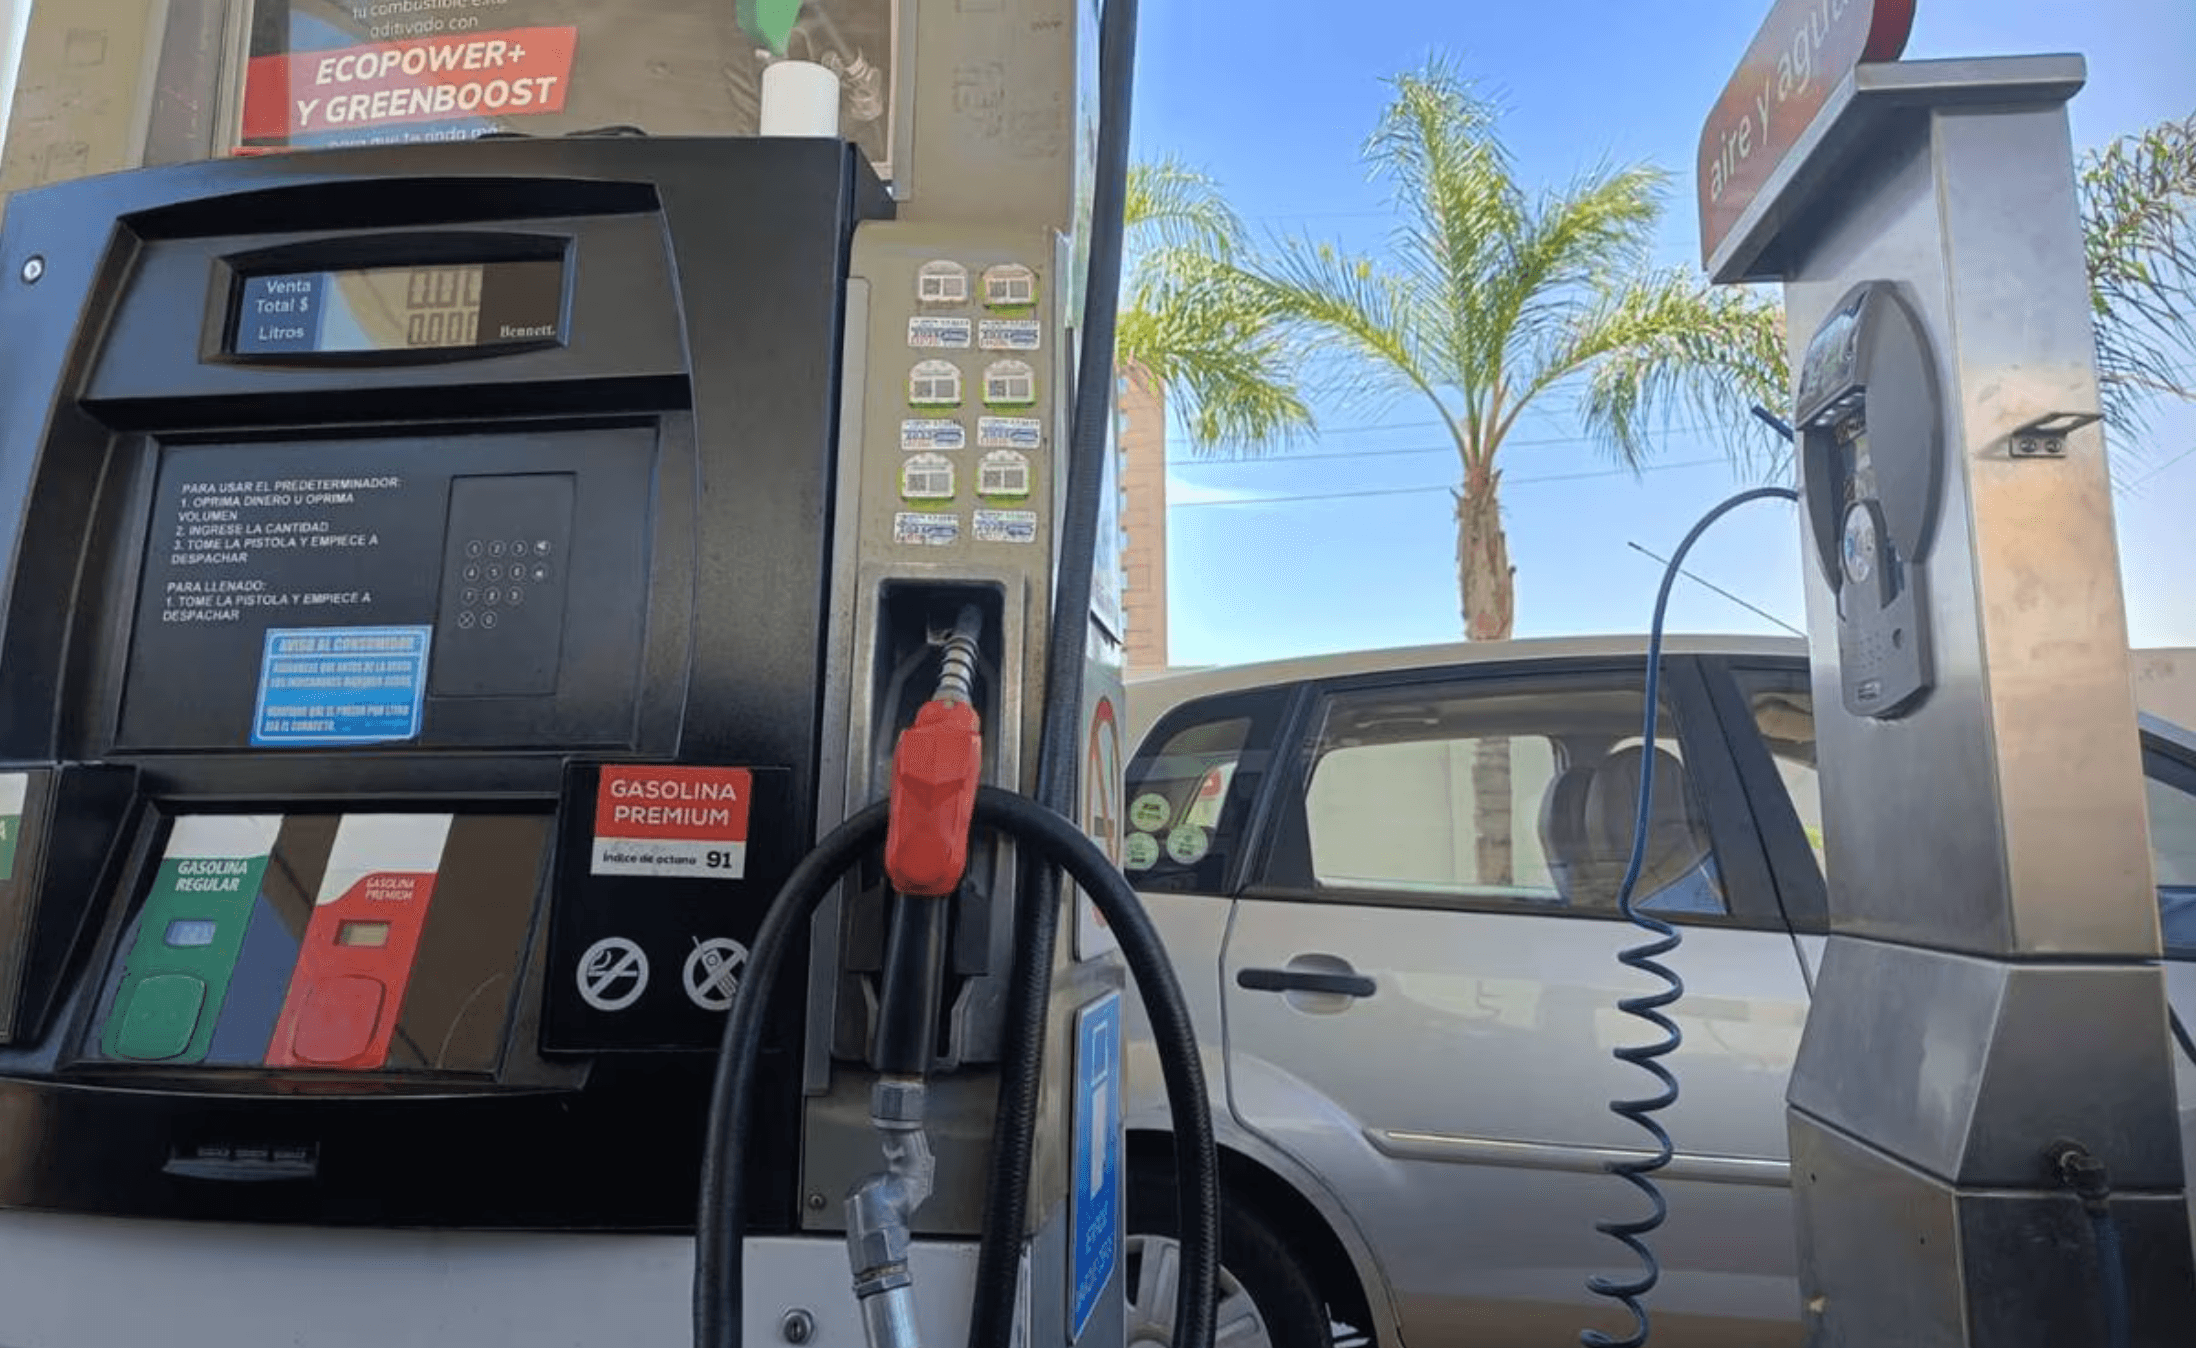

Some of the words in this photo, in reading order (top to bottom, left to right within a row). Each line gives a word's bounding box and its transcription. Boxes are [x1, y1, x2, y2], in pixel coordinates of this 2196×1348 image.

[370, 15, 445, 39] aditivado
[449, 15, 479, 31] con
[315, 39, 527, 86] ECOPOWER+
[297, 98, 319, 127] Y
[325, 76, 558, 124] GREENBOOST
[1711, 115, 1751, 202] aire
[1757, 78, 1771, 146] y
[266, 279, 311, 294] Venta
[256, 298, 295, 313] Total
[299, 297, 309, 313] $
[258, 326, 305, 341] Litros
[182, 483, 216, 494] PARA
[219, 481, 252, 493] USAR
[255, 481, 271, 492] EL
[193, 495, 240, 508] OPRIMA
[243, 494, 291, 507] DINERO
[305, 492, 354, 505] OPRIMA
[178, 511, 238, 522] VOLUMEN
[189, 524, 243, 537] INGRESE
[246, 524, 263, 535] LA
[265, 521, 330, 534] CANTIDAD
[188, 538, 222, 551] TOME
[224, 537, 240, 550] LA
[244, 536, 296, 549] PISTOLA
[300, 537, 309, 547] Y
[311, 534, 366, 548] EMPIECE
[368, 534, 379, 545] A
[171, 552, 249, 565] DESPACHAR
[167, 581, 201, 593] PARA
[179, 594, 214, 607] TOME
[216, 594, 233, 606] LA
[235, 593, 289, 606] PISTOLA
[291, 593, 301, 605] Y
[302, 591, 359, 605] EMPIECE
[361, 592, 372, 603] A
[163, 609, 240, 622] DESPACHAR
[610, 779, 737, 802] GASOLINA
[614, 805, 729, 827] PREMIUM
[706, 850, 732, 869] 91
[177, 860, 248, 876] GASOLINA
[175, 877, 240, 892] REGULAR
[365, 877, 416, 890] GASOLINA
[365, 889, 414, 901] PREMIUM
